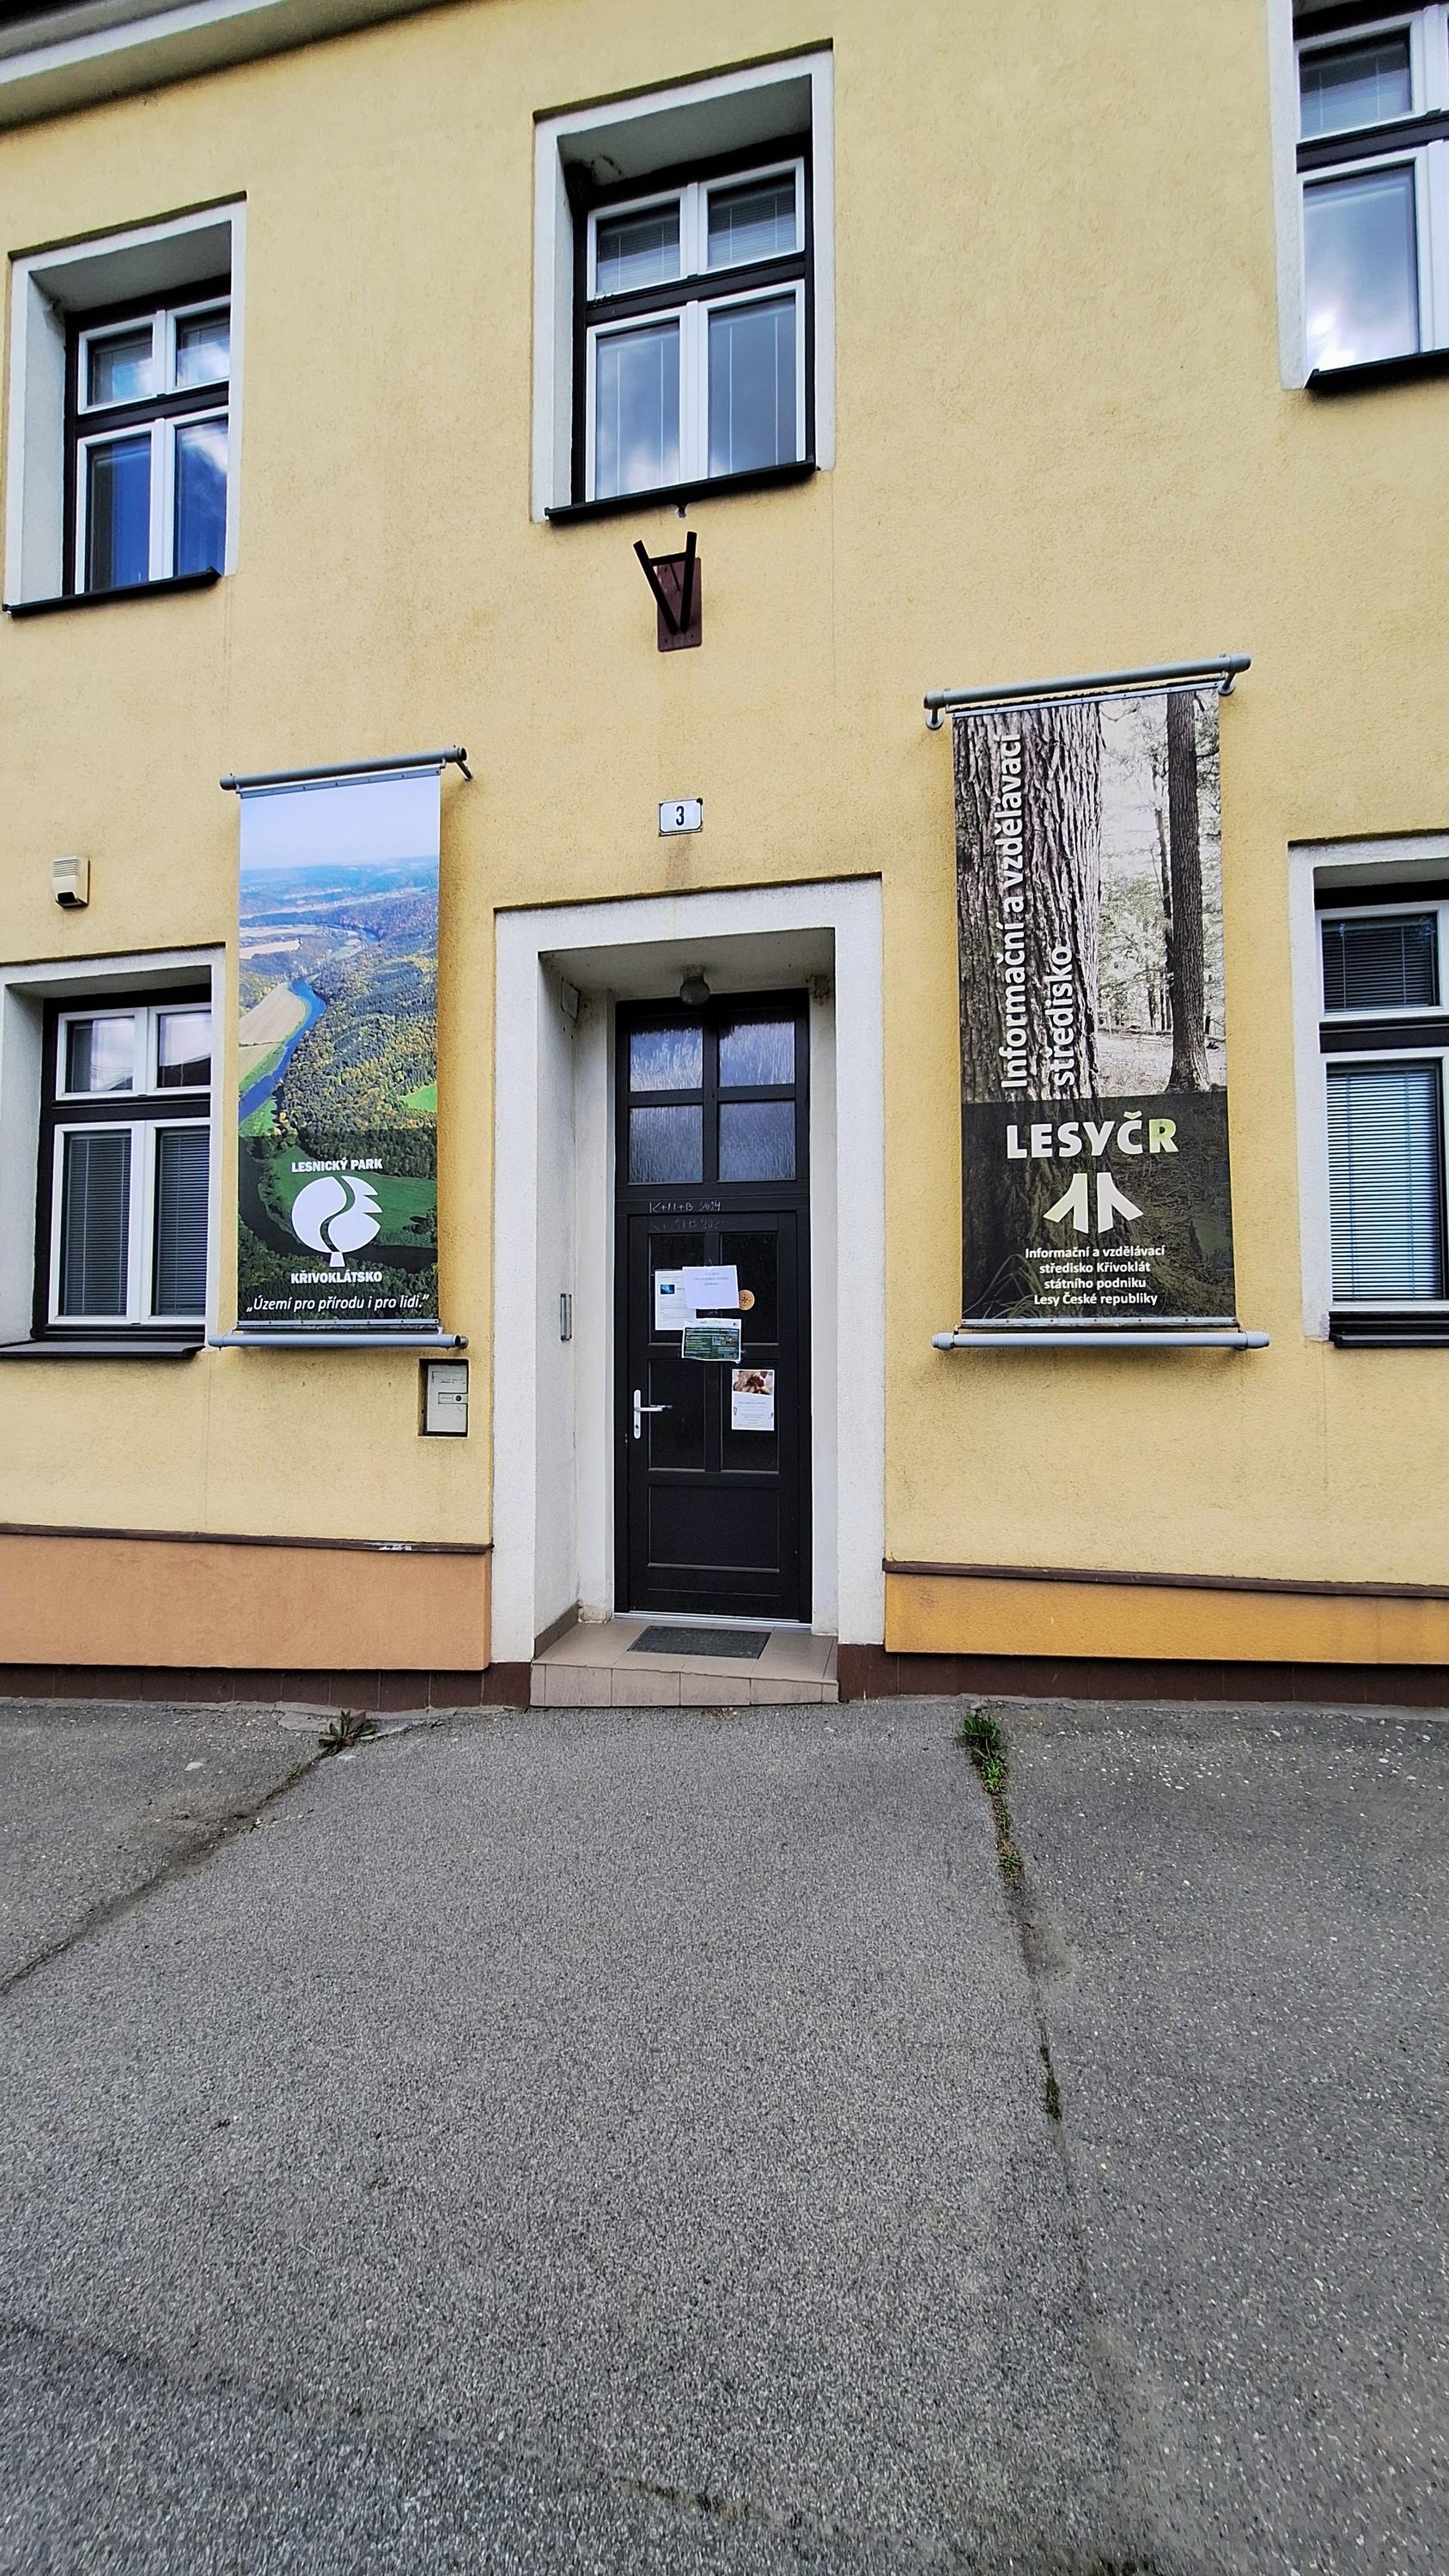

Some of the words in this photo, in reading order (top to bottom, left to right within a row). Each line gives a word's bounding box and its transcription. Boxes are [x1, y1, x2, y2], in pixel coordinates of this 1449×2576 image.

[676, 805, 685, 826] 3
[994, 734, 1024, 889] vzdělávací
[1002, 896, 1025, 914] a
[996, 921, 1027, 1089] Informační
[1039, 945, 1075, 1087] středisko
[291, 1157, 348, 1173] LESNICKÝ
[350, 1157, 383, 1170] PARK
[1025, 1246, 1090, 1259] Informační
[1092, 1249, 1100, 1257] a
[1102, 1244, 1166, 1257] vzdělávací
[1038, 1262, 1093, 1274] středisko
[1096, 1261, 1151, 1273] Křivoklát
[290, 1270, 383, 1285] KŘIVOKLÁTSKO
[1044, 1278, 1094, 1290] státního
[1096, 1276, 1147, 1291] podniku
[246, 1295, 293, 1312] „Území
[293, 1299, 315, 1313] pro
[317, 1295, 365, 1313] přírodu
[367, 1296, 373, 1309] i
[374, 1298, 397, 1311] pro
[1033, 1293, 1060, 1307] Lesy
[1062, 1291, 1098, 1304] České
[1099, 1291, 1159, 1306] republiky
